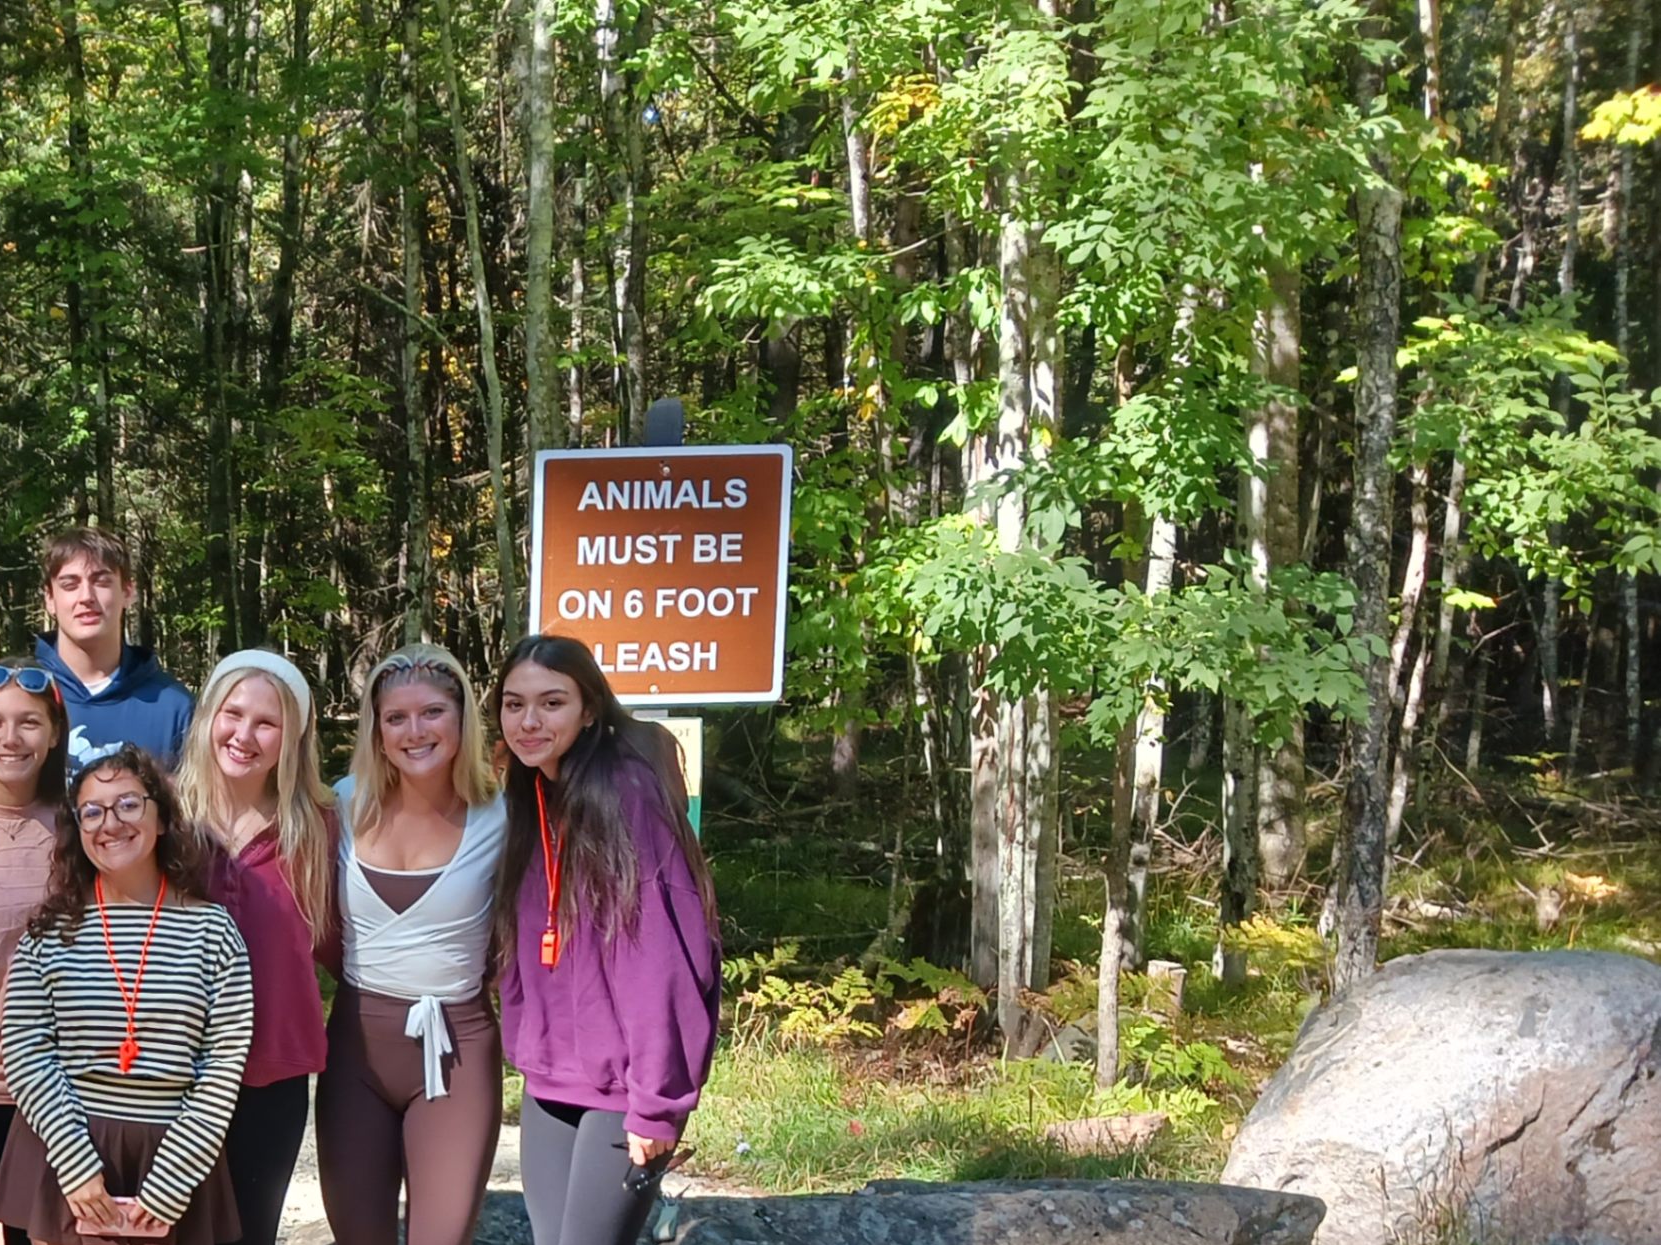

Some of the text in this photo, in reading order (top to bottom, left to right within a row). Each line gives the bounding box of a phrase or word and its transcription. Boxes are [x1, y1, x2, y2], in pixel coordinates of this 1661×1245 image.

[577, 478, 748, 512] ANIMALS
[577, 533, 743, 566] MUST BE
[558, 587, 759, 620] ON 6 FOOT
[594, 641, 718, 673] LEASH
